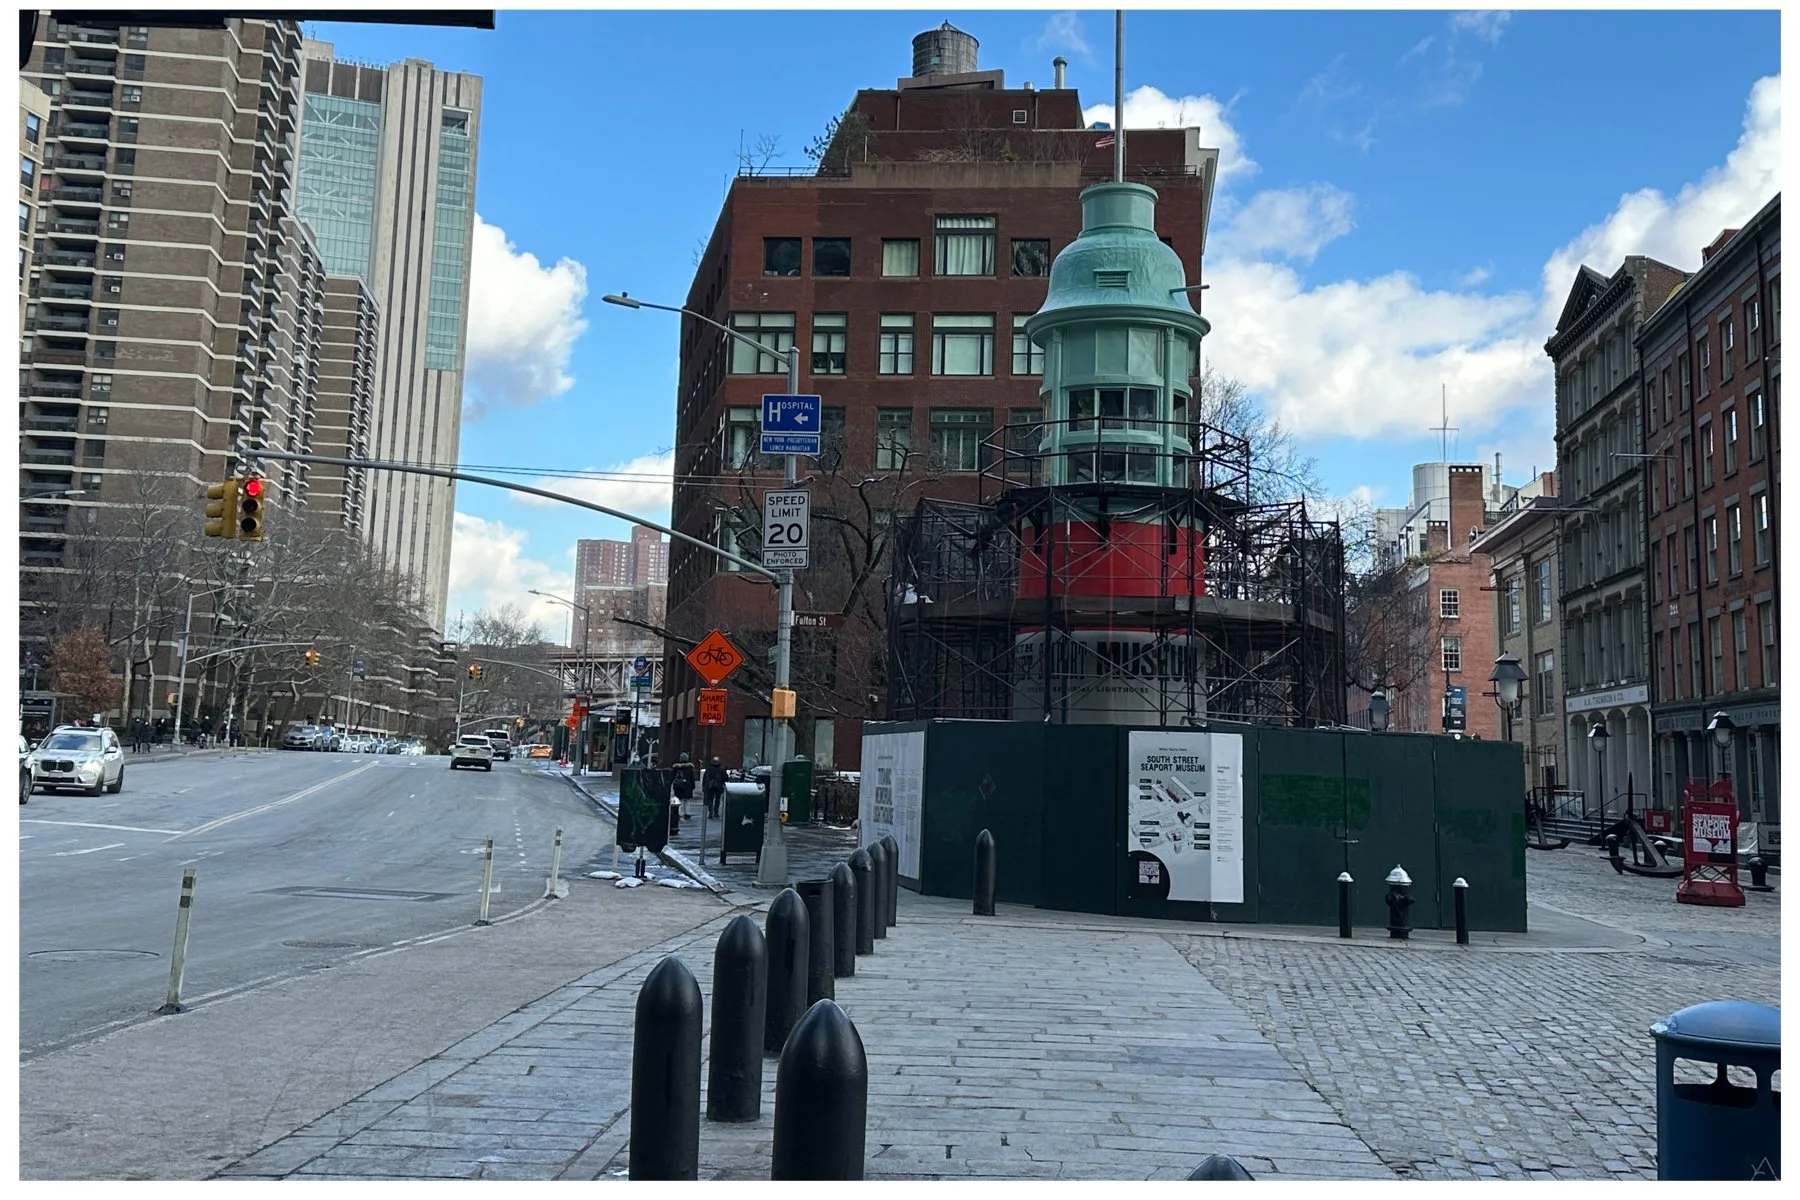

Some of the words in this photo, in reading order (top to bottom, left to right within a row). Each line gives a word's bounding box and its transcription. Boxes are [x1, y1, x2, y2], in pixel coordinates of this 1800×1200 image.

[768, 401, 814, 422] HOSPITAL
[768, 495, 806, 506] SPEED
[771, 508, 801, 518] LIMIT
[768, 522, 804, 544] 20
[795, 615, 817, 626] Fulton
[818, 616, 827, 626] St
[702, 694, 725, 702] SHARE
[702, 712, 721, 720] ROAD
[1146, 755, 1171, 763] SOUTH
[1173, 756, 1199, 764] STREET
[1140, 763, 1173, 772] SEAPORT
[1175, 764, 1206, 773] MUSEUM
[1692, 820, 1730, 830] SEAPORT
[1692, 829, 1731, 839] MUSEUM
